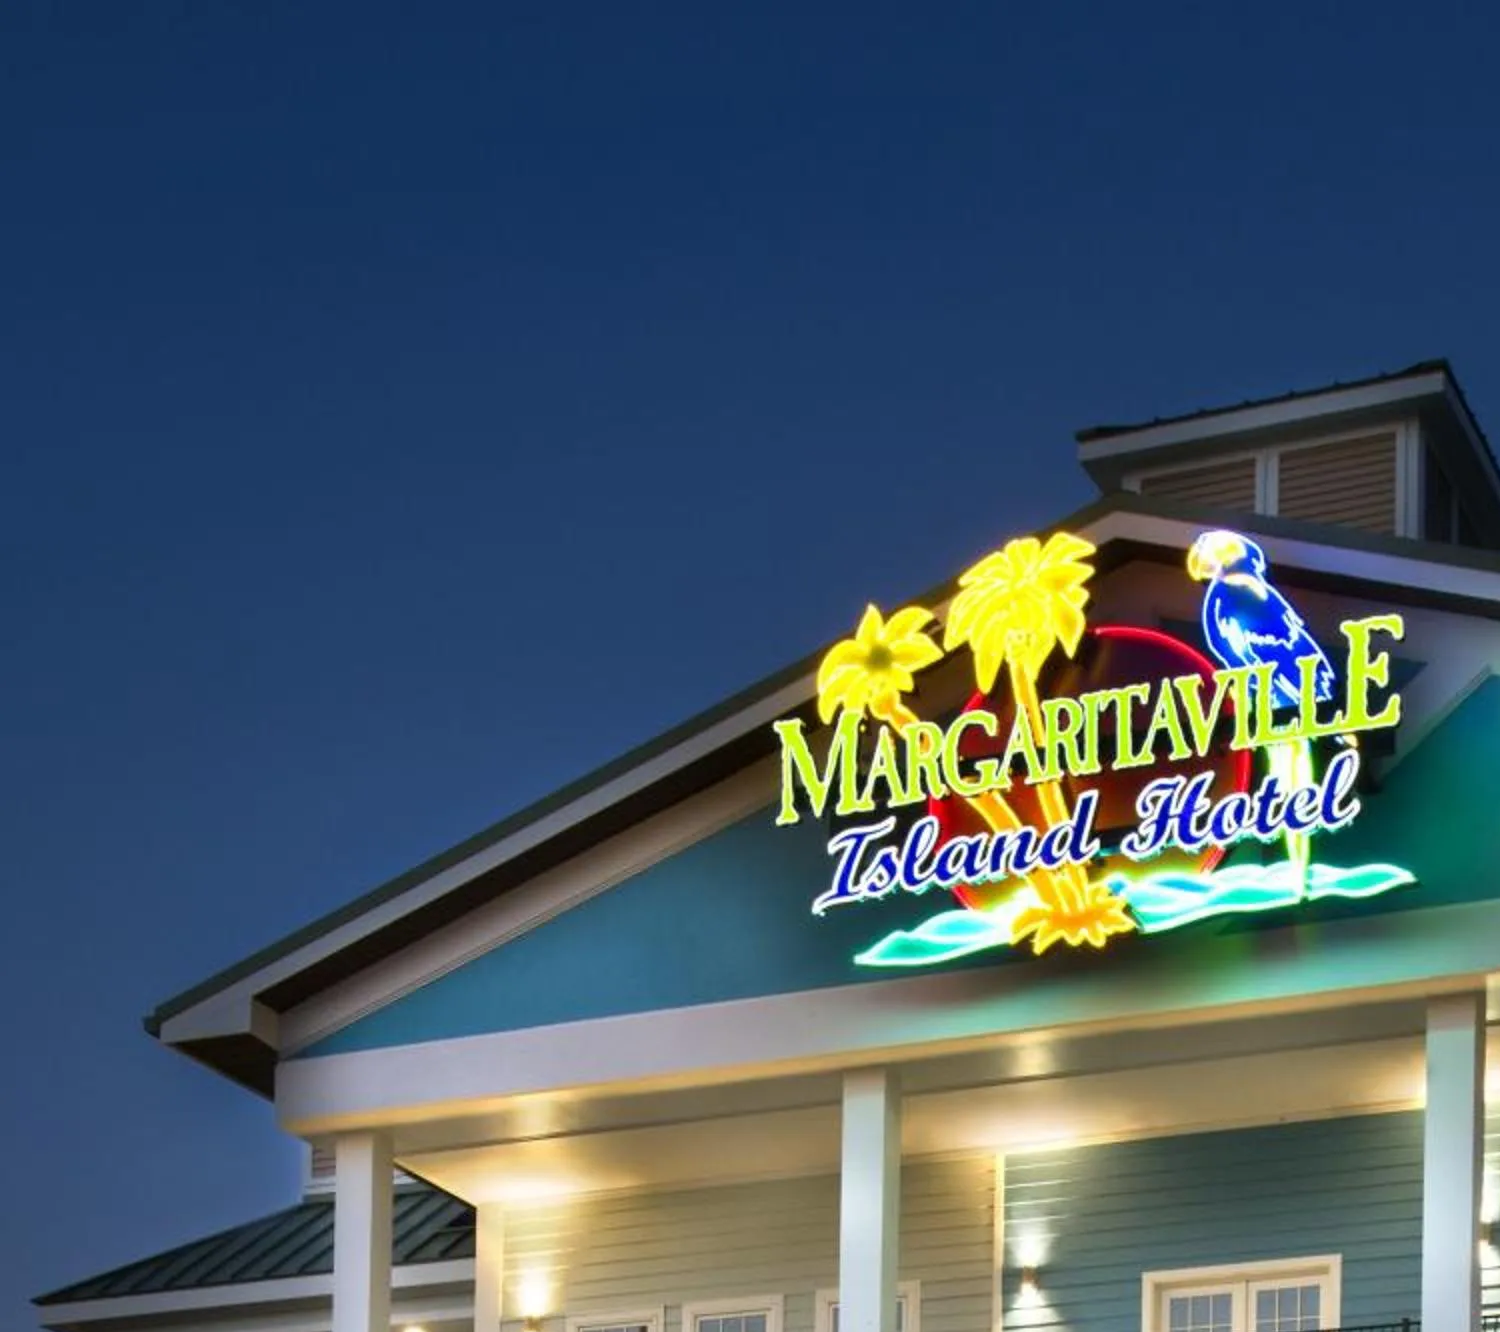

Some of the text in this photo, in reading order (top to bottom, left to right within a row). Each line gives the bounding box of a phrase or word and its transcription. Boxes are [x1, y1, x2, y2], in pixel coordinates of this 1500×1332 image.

[774, 614, 1404, 825] MARGARITAVILLE
[812, 748, 1360, 913] Island Hotel
